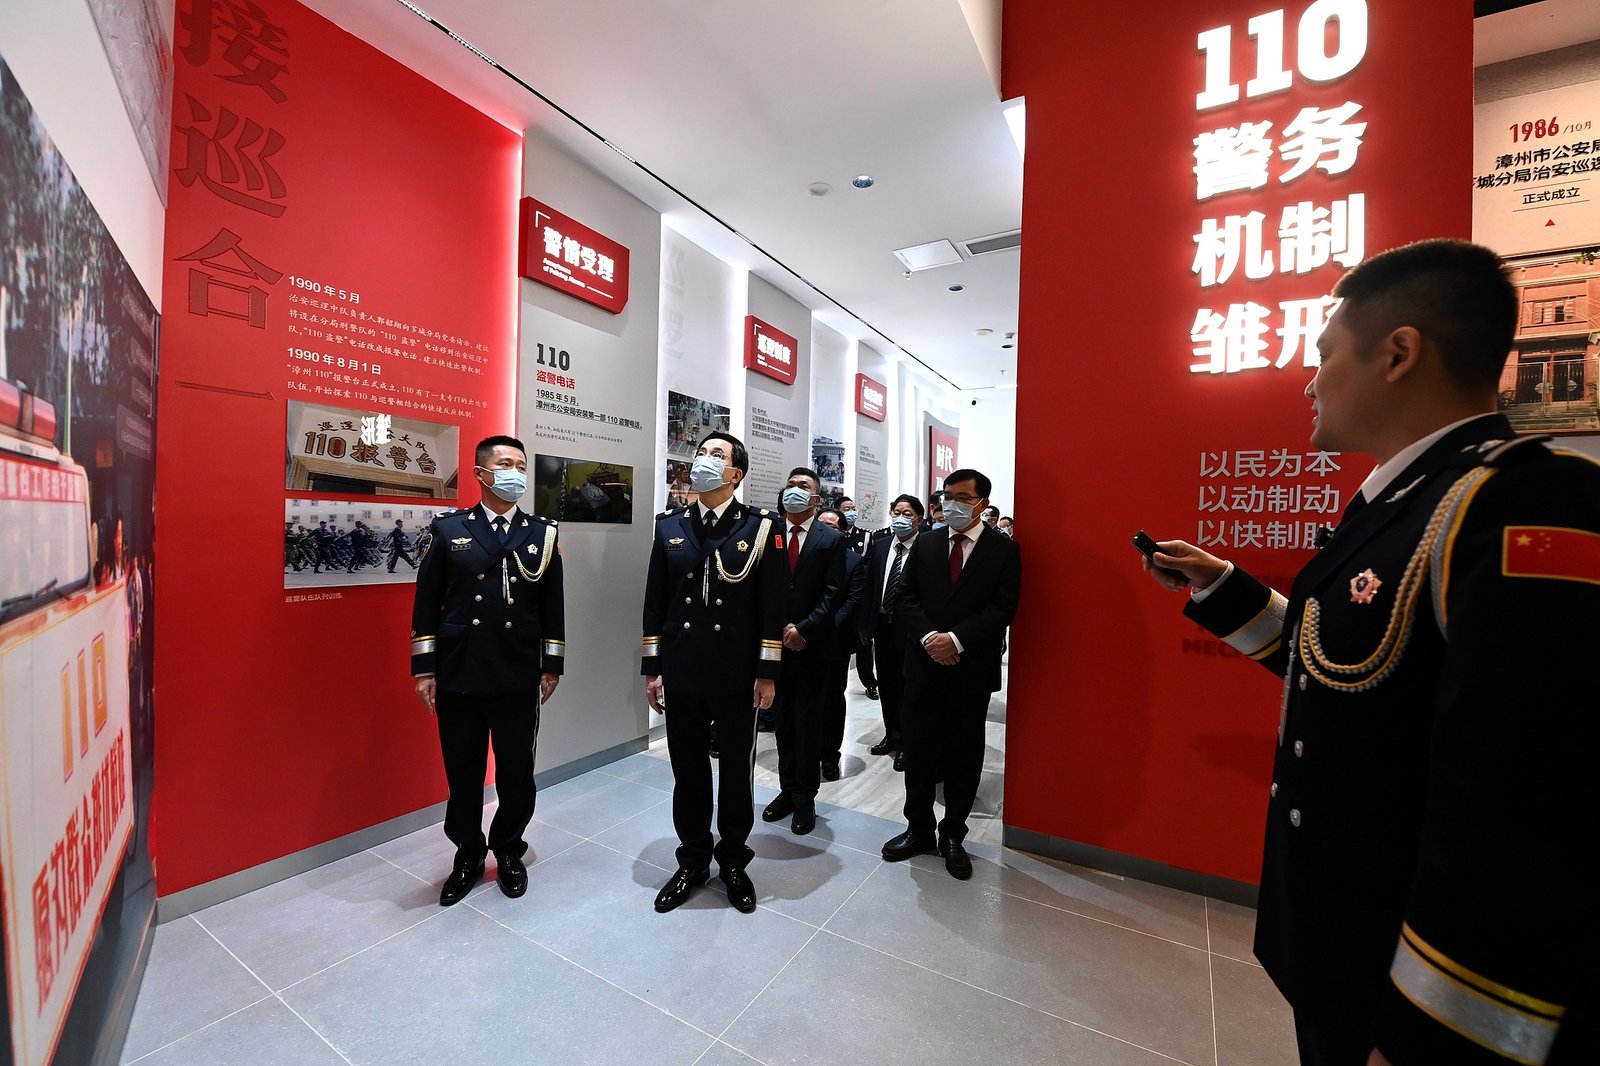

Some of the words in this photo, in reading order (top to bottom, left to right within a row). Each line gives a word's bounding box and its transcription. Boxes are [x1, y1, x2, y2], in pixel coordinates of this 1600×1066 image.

[1196, 0, 1368, 110] 110
[1510, 116, 1559, 143] 1986
[1192, 100, 1368, 200] 警务
[1522, 187, 1580, 205] 正式成立
[543, 226, 615, 282] 警情受理
[1190, 193, 1366, 287] 机制
[536, 343, 571, 371] 110
[536, 369, 576, 390] 盗警电话
[936, 444, 954, 472] 时代
[1199, 448, 1342, 478] 以民为本
[1197, 484, 1340, 514] 以动制动
[61, 632, 108, 783] 110
